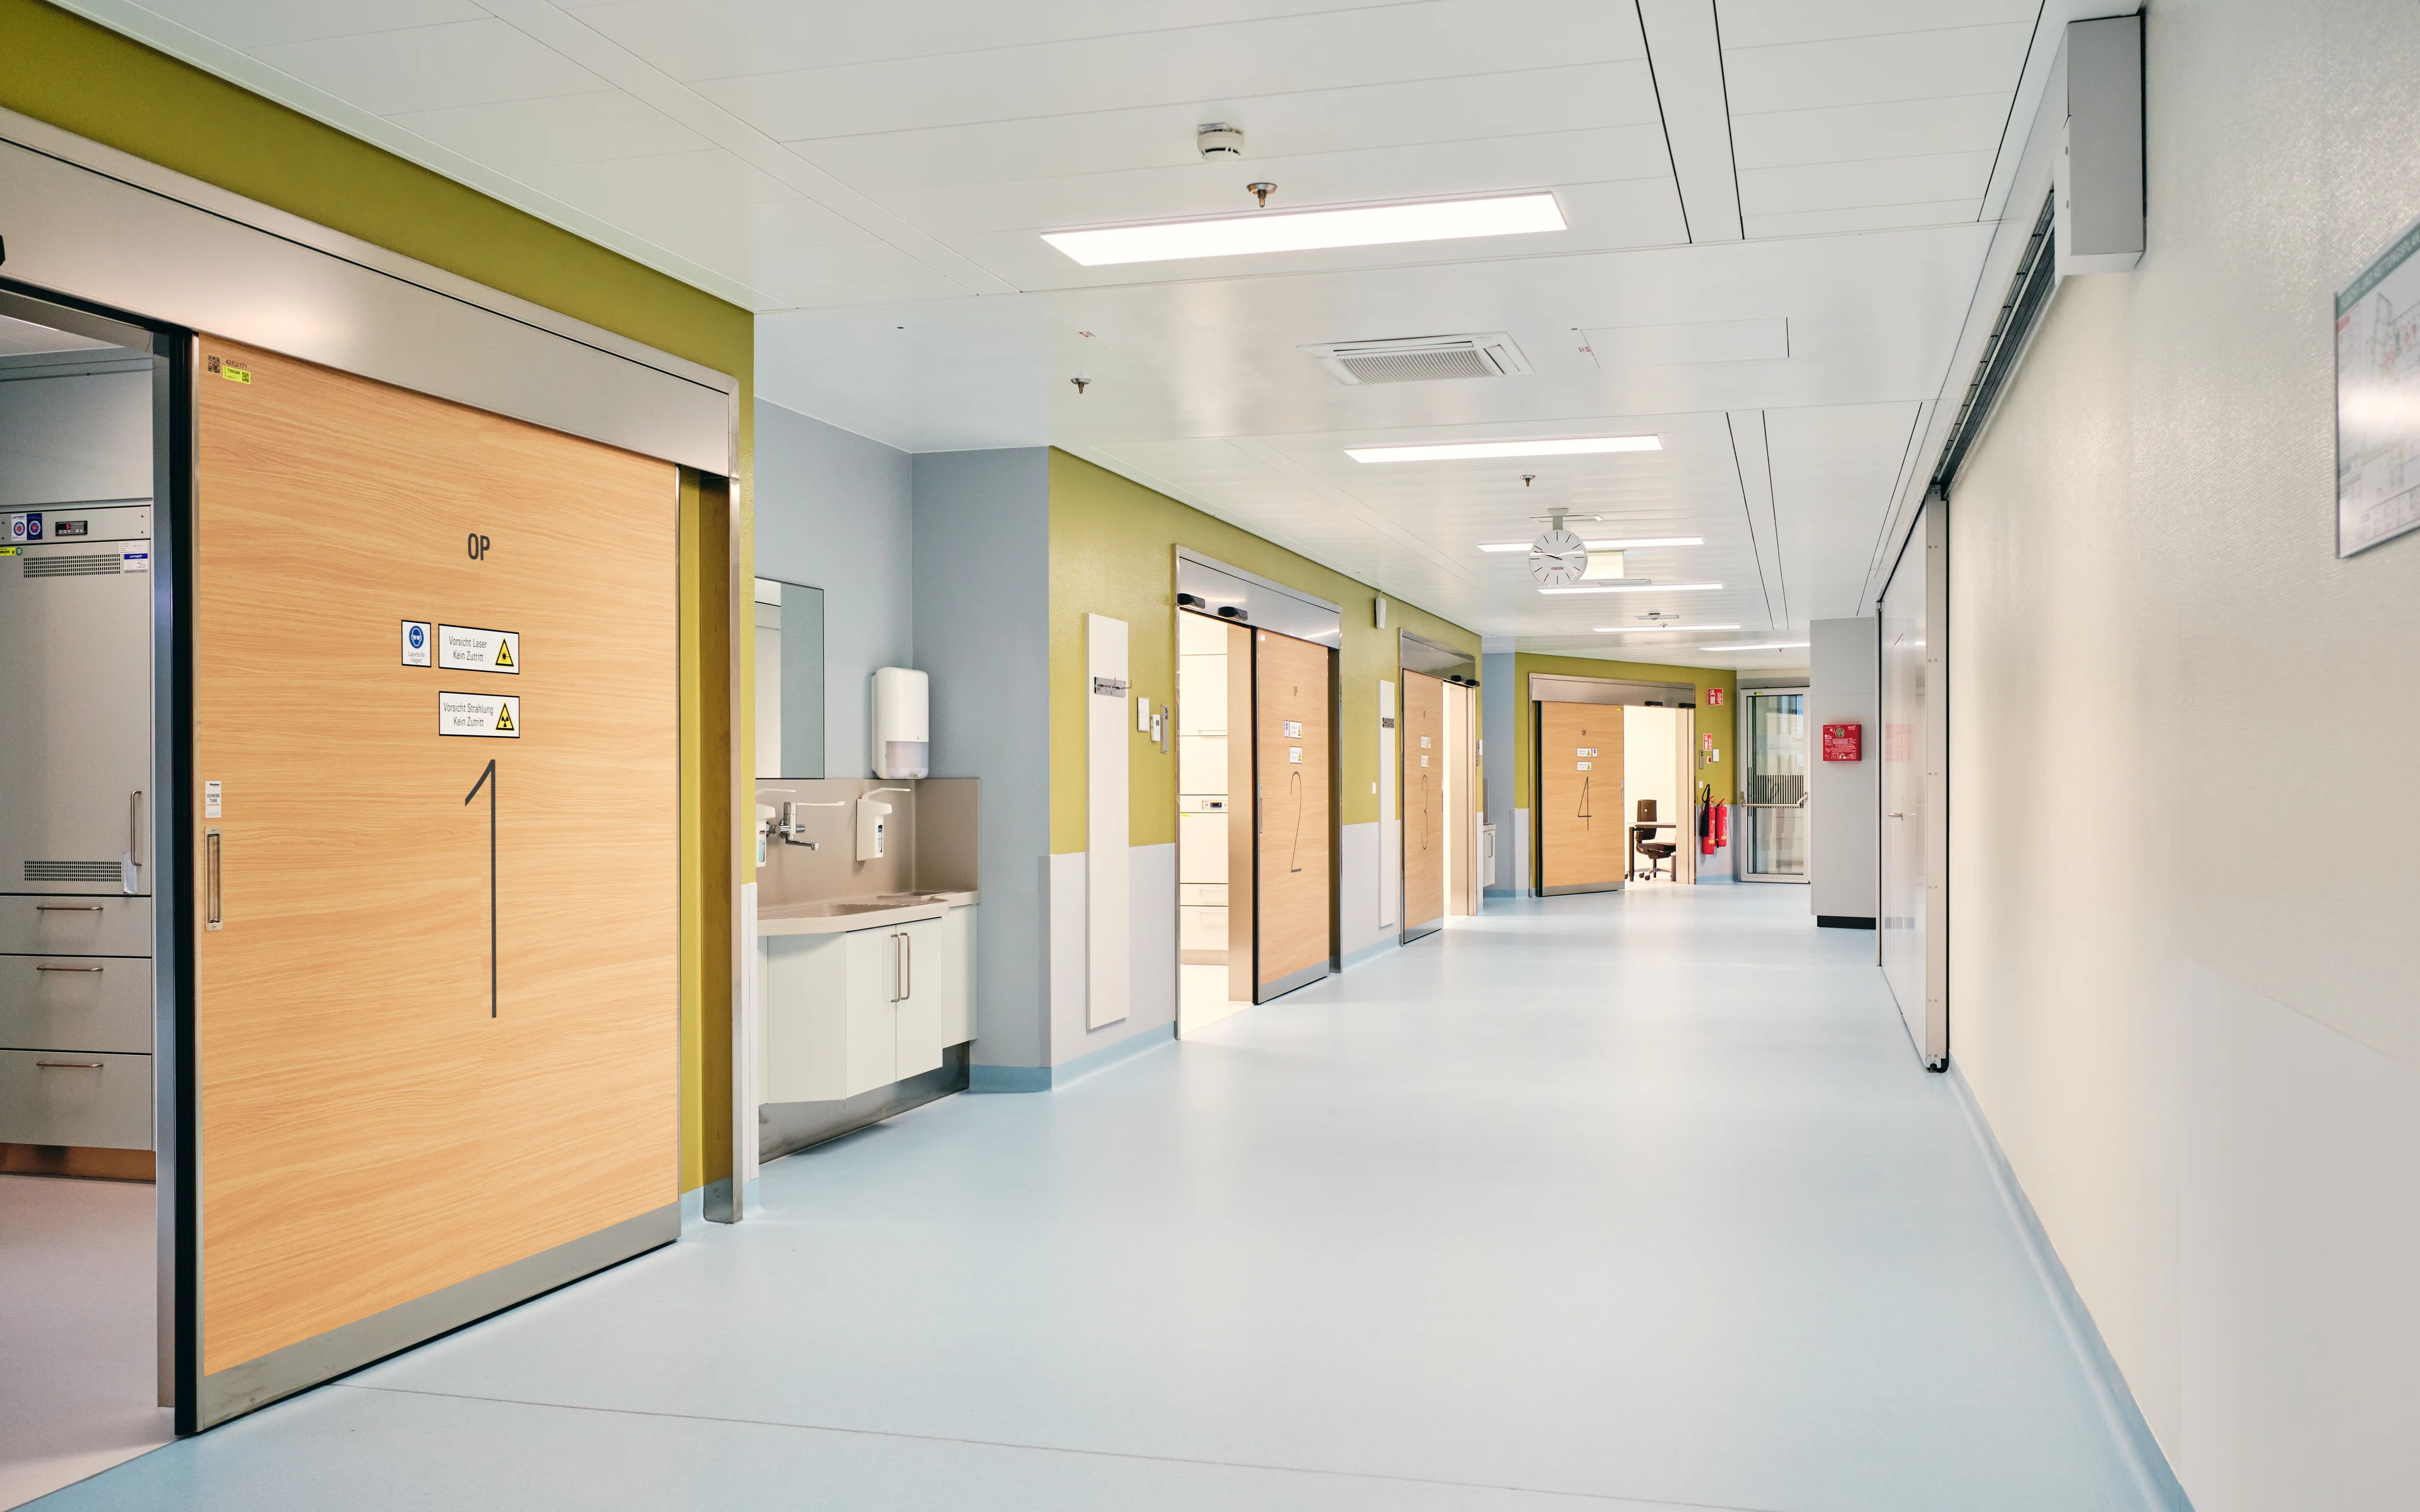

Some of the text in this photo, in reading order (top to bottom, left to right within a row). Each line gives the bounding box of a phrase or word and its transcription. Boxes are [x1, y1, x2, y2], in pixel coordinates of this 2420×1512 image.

[226, 359, 247, 369] 42/E2/171
[468, 533, 490, 561] OP
[448, 635, 487, 649] Vorsicht Laser
[453, 650, 484, 662] Kein Zutritt
[443, 702, 493, 716] Vorsicht Strahlung
[454, 716, 484, 727] Kein Zutritt
[1421, 774, 1428, 850] 3
[1577, 776, 1592, 831] 4
[1290, 771, 1302, 873] 2
[465, 760, 496, 1018] 1
